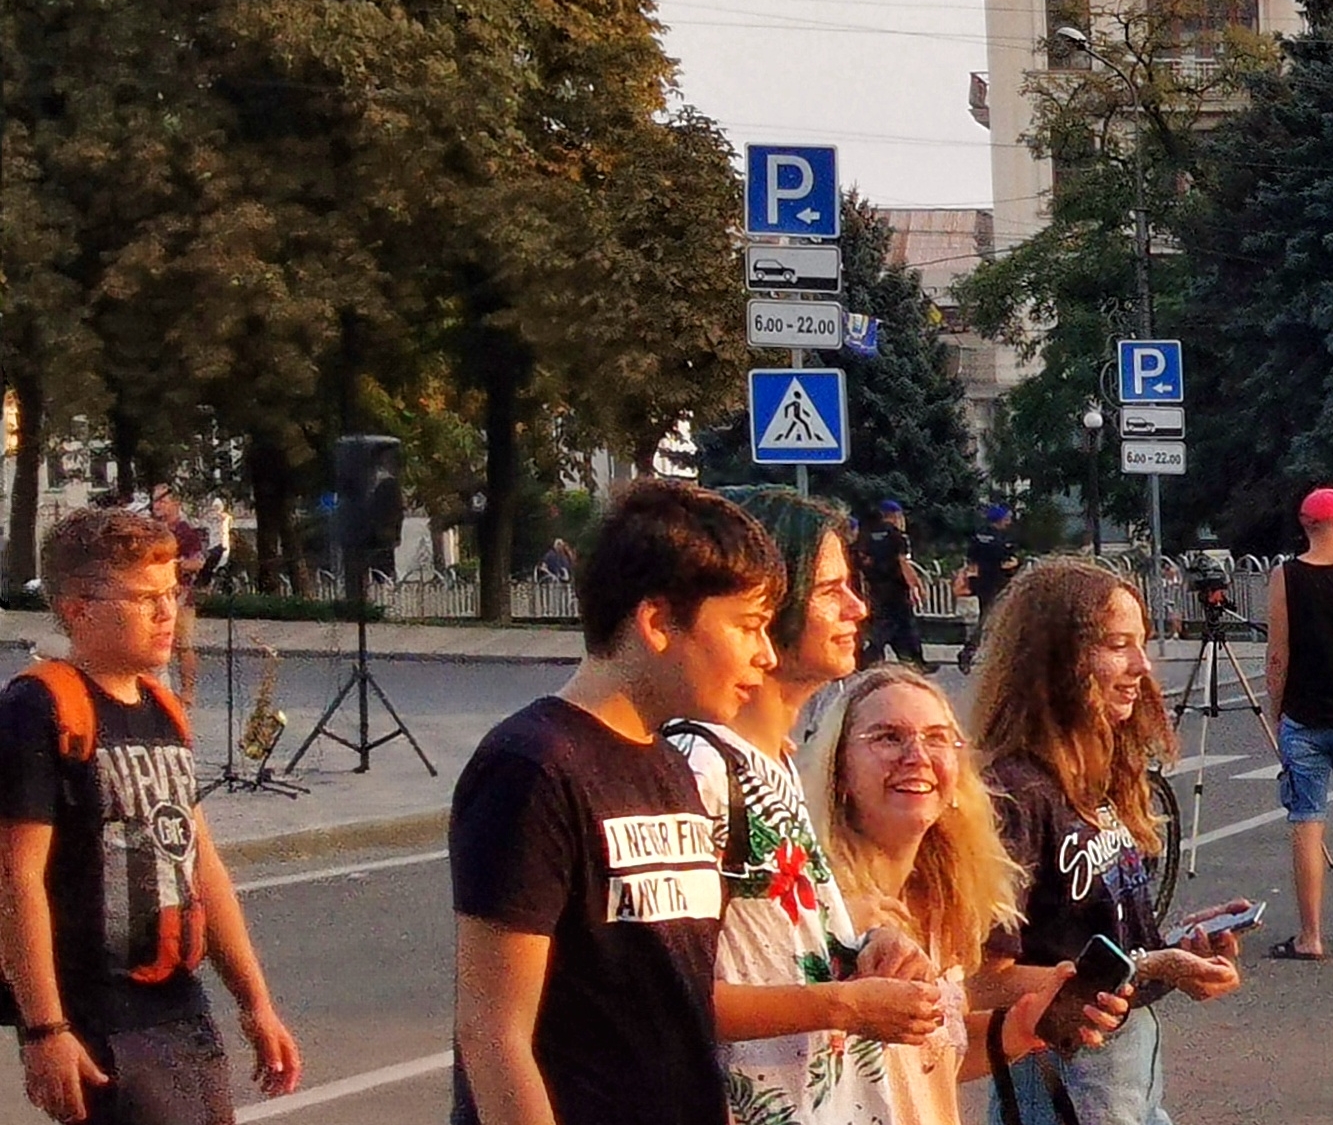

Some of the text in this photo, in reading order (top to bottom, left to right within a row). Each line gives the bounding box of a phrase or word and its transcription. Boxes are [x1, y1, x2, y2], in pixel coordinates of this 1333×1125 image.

[767, 154, 814, 225] P
[755, 315, 783, 333] 6.00
[1134, 348, 1166, 394] P
[610, 825, 622, 862] I
